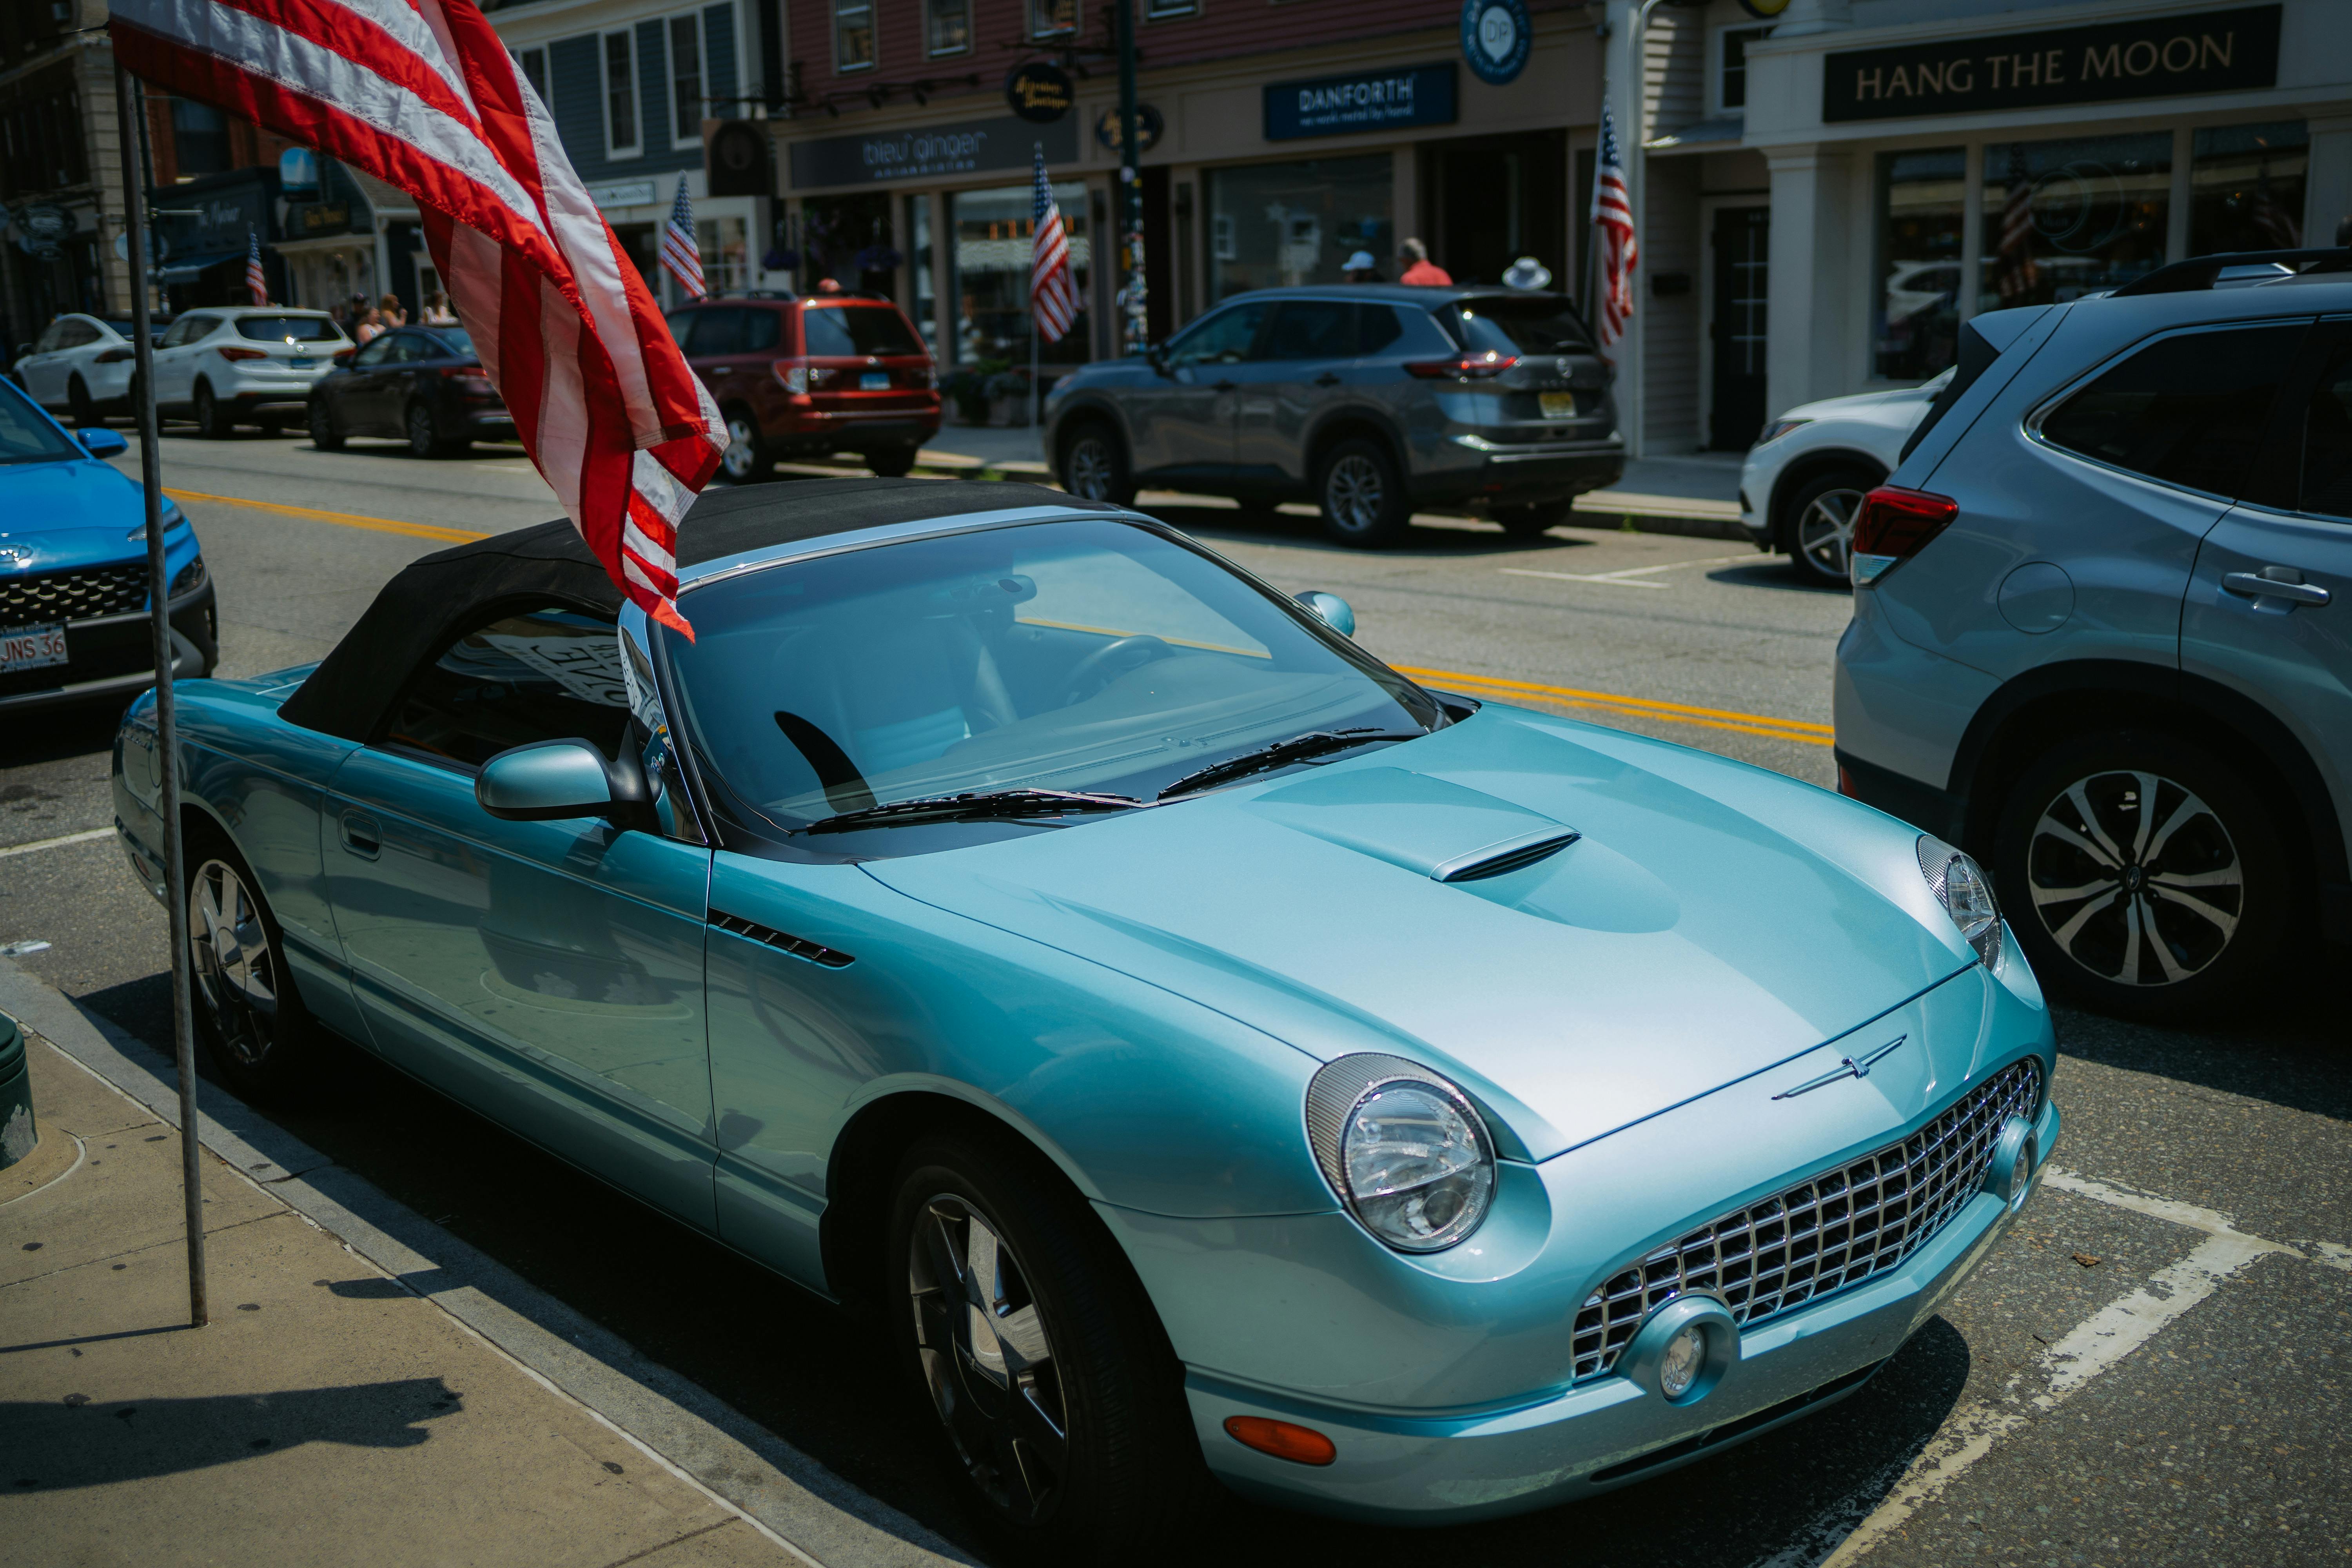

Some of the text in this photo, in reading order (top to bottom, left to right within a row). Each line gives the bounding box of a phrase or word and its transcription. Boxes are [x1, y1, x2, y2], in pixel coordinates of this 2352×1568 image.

[1856, 32, 2234, 100] HANG THE MOON
[1298, 77, 1414, 112] DANFORTH
[0, 632, 65, 661] JNS 36
